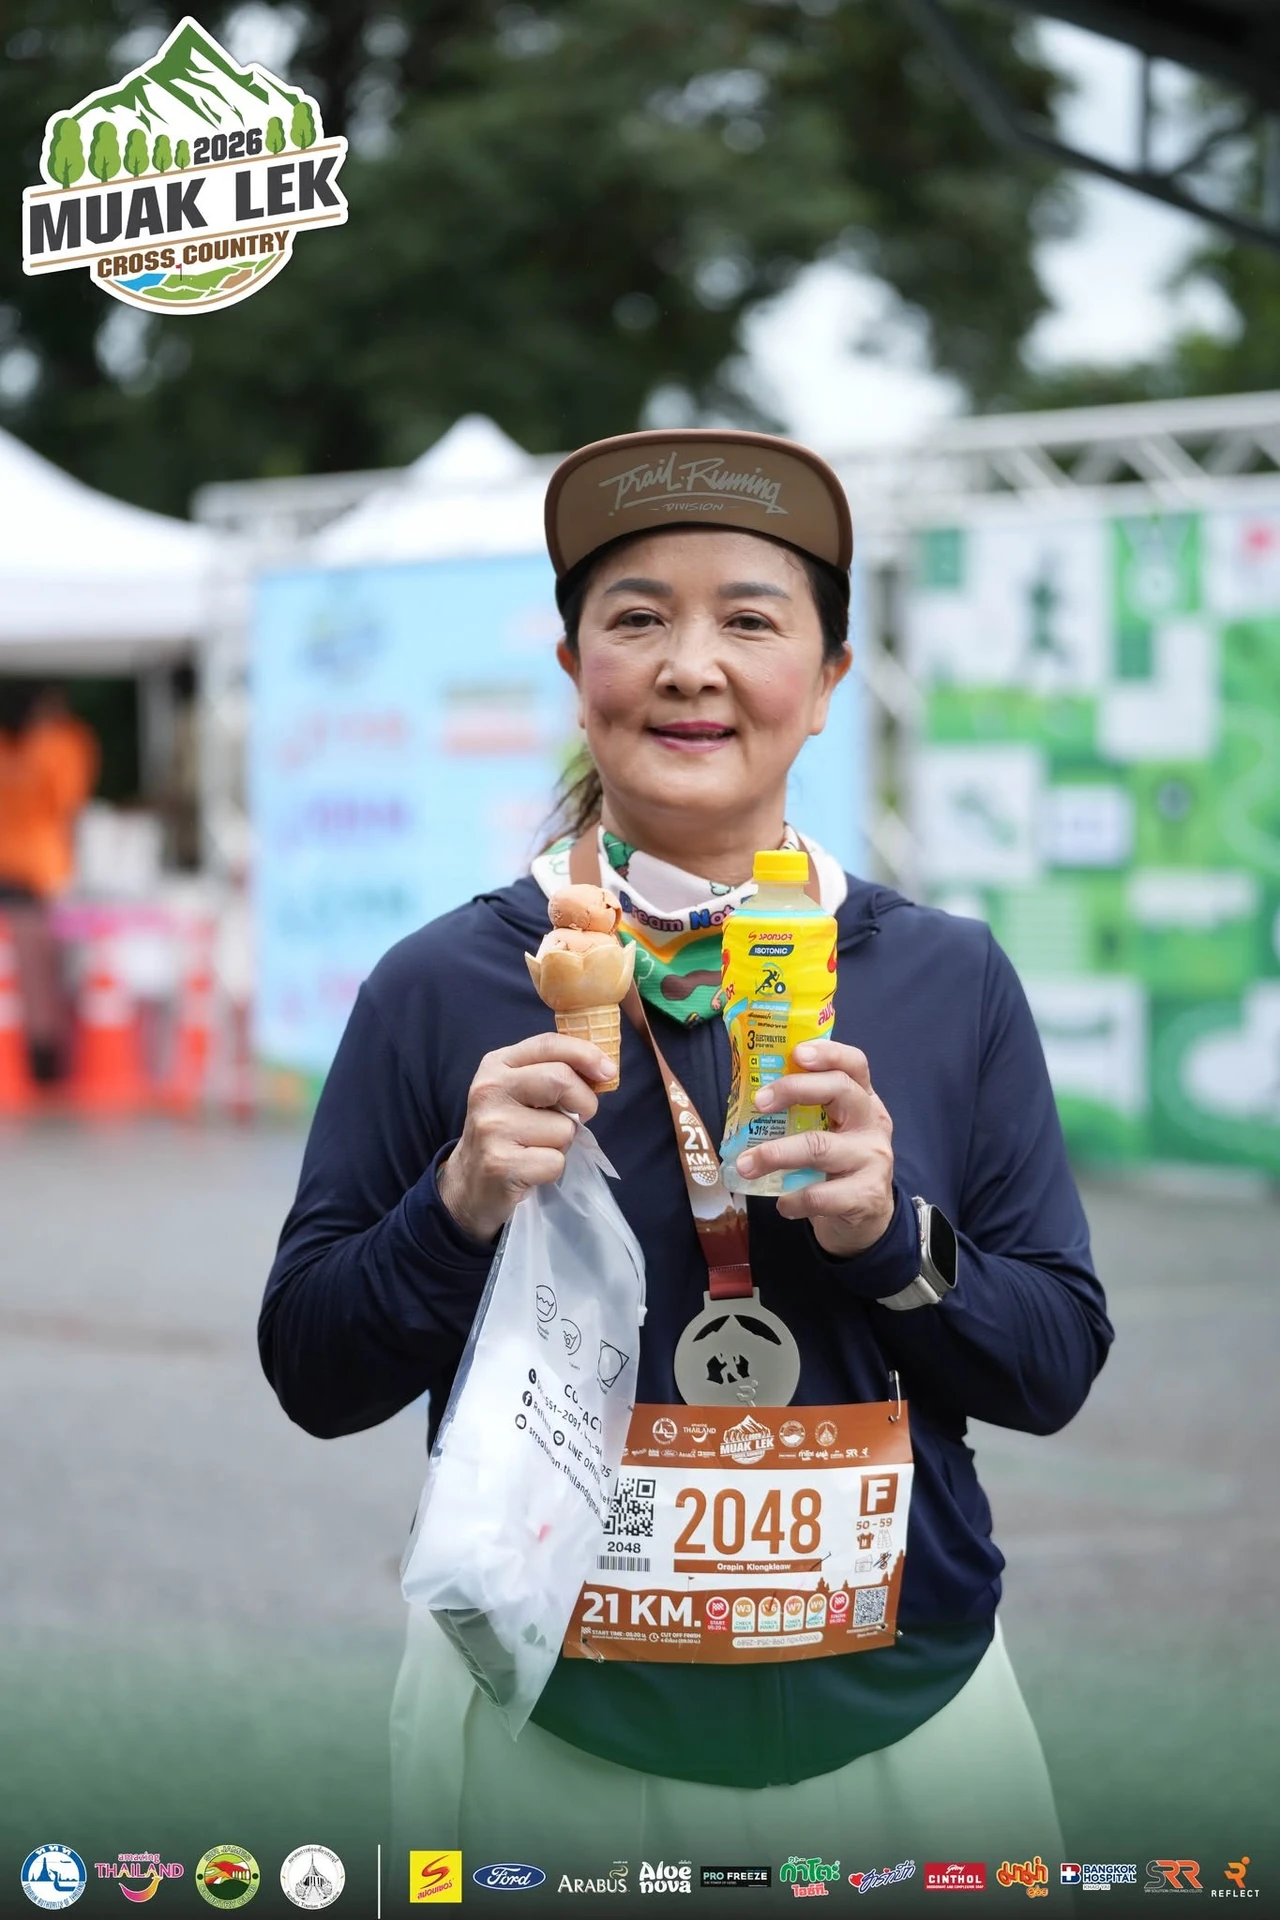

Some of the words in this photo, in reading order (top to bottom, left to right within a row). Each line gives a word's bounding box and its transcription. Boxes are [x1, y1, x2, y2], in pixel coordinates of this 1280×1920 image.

[599, 451, 682, 510] Trail
[663, 503, 723, 511] DIVISION
[758, 933, 793, 941] SPONSOR
[747, 1030, 755, 1050] 3
[681, 1125, 709, 1150] 21
[686, 1152, 714, 1165] KM.
[720, 1441, 751, 1454] MUAK
[755, 1437, 774, 1449] LEK
[867, 1479, 890, 1512] F
[674, 1487, 822, 1555] 2048
[856, 1520, 870, 1530] 50
[879, 1517, 892, 1527] 59
[607, 1541, 641, 1554] 2048
[717, 1563, 744, 1571] Orapin
[582, 1591, 619, 1624] 21
[630, 1594, 701, 1627] KM.
[737, 1604, 751, 1612] W3
[788, 1602, 801, 1611] W7
